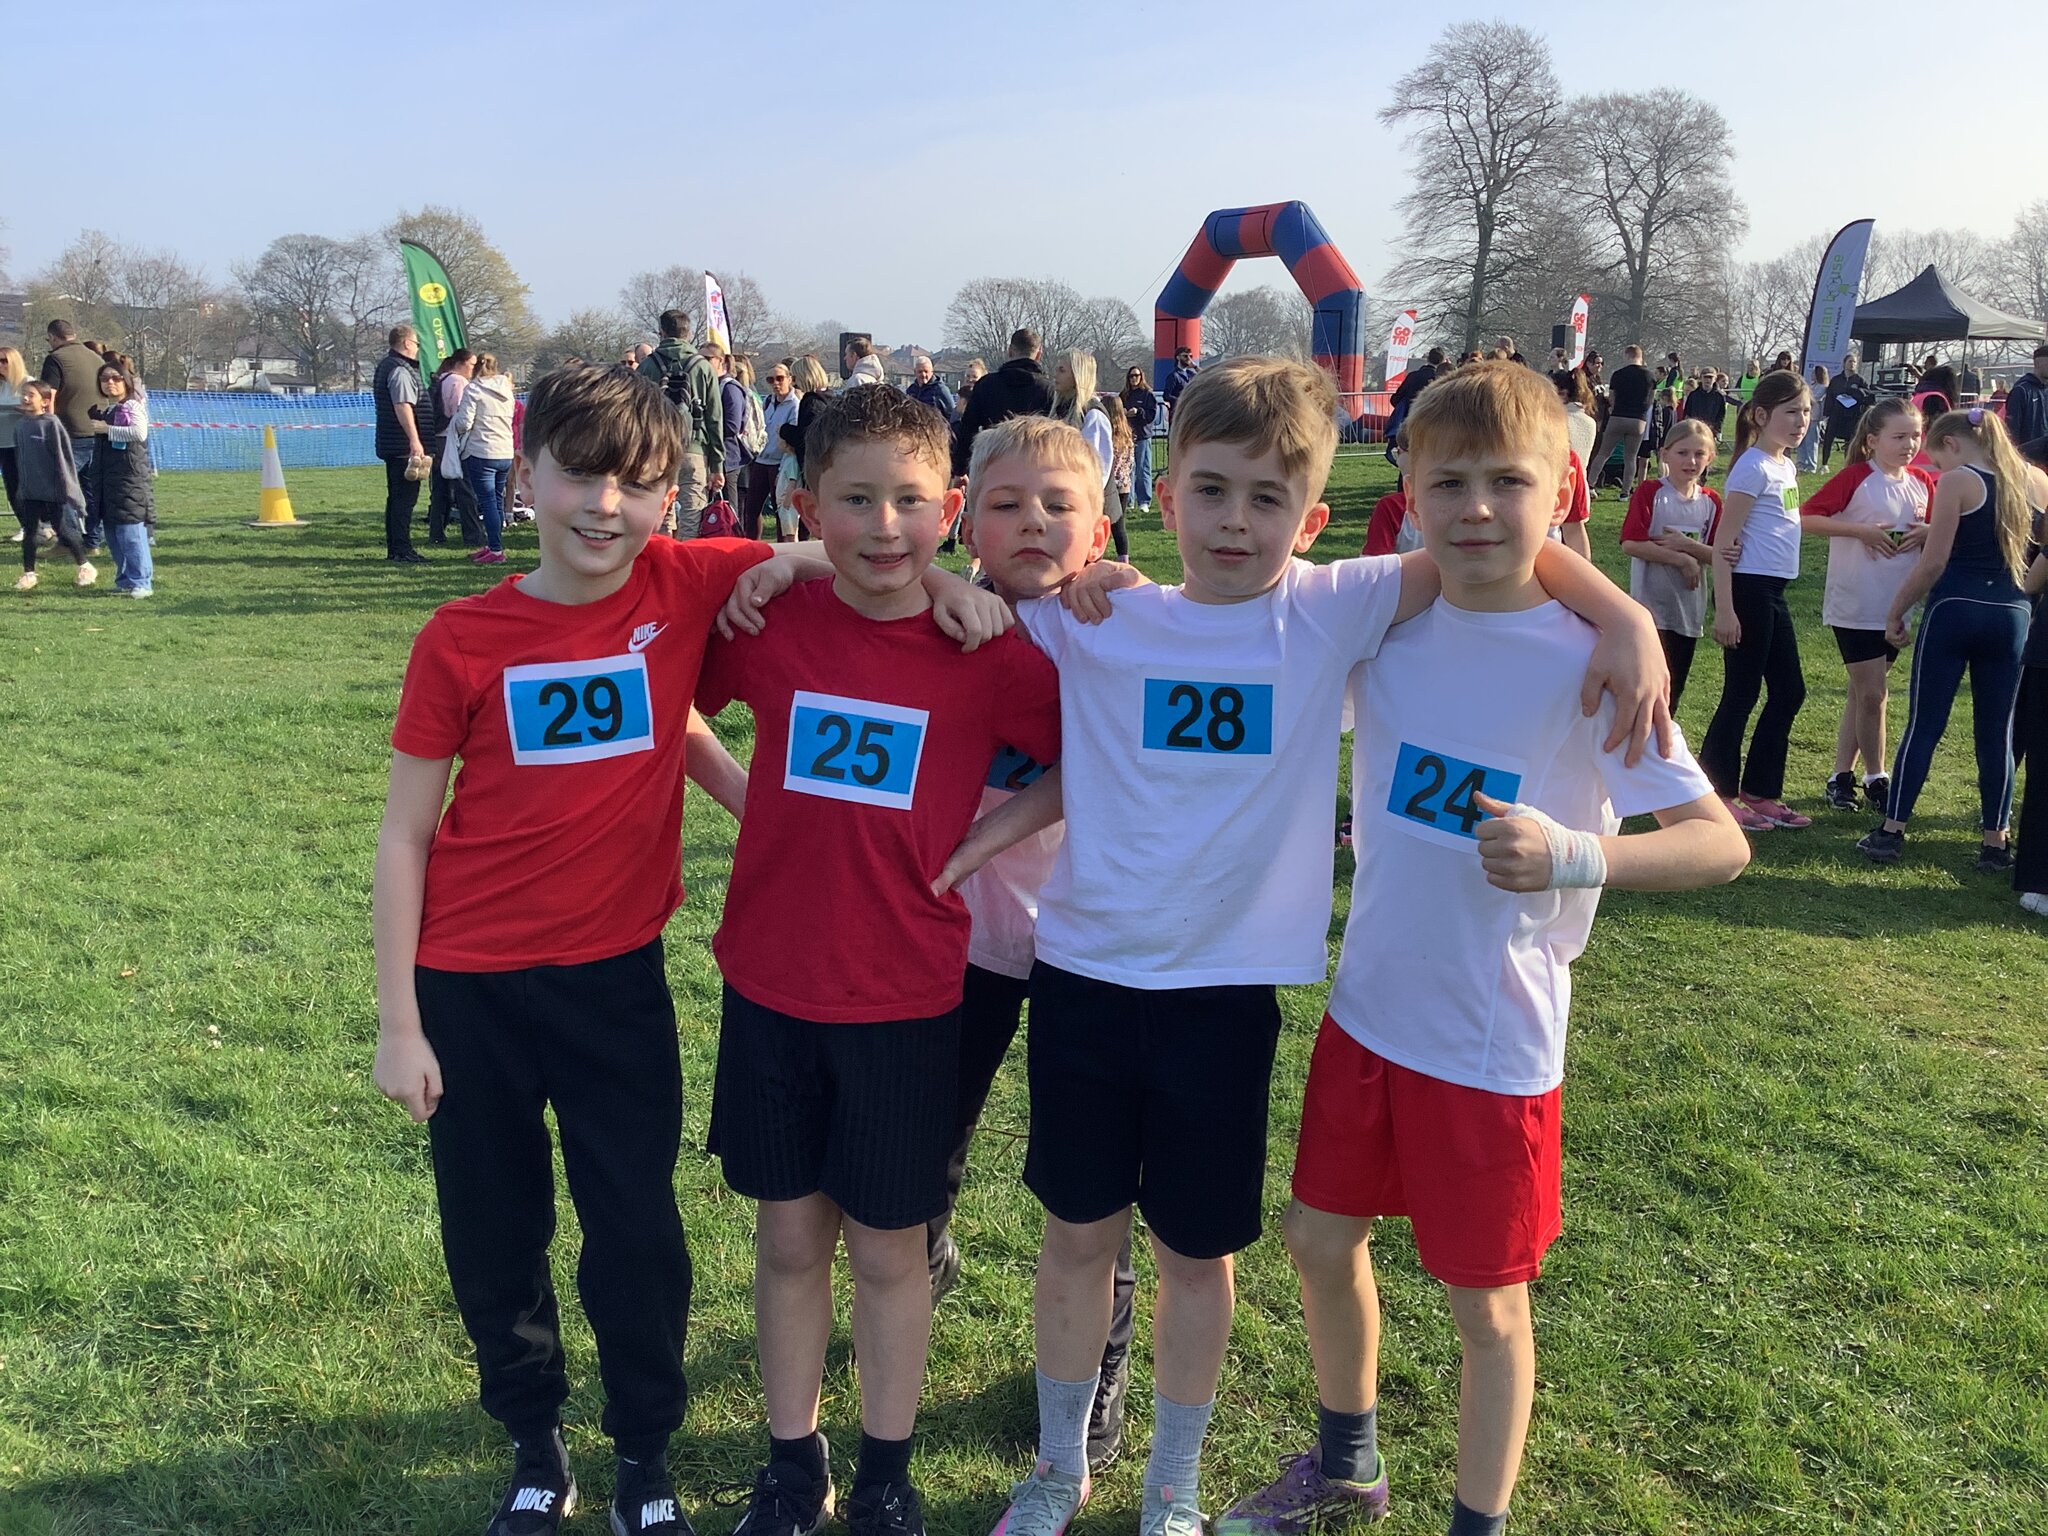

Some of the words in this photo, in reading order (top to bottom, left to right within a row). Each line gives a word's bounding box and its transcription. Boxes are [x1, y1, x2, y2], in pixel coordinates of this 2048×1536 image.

[1392, 336, 1409, 346] TRI
[1394, 327, 1411, 336] GO
[1816, 307, 1833, 351] derian
[632, 621, 657, 643] NIKE
[538, 677, 623, 746] 29
[1165, 684, 1246, 751] 28
[810, 714, 895, 786] 25
[1404, 755, 1486, 833] 24
[510, 1487, 556, 1514] NIKE
[641, 1499, 676, 1530] NIKE
